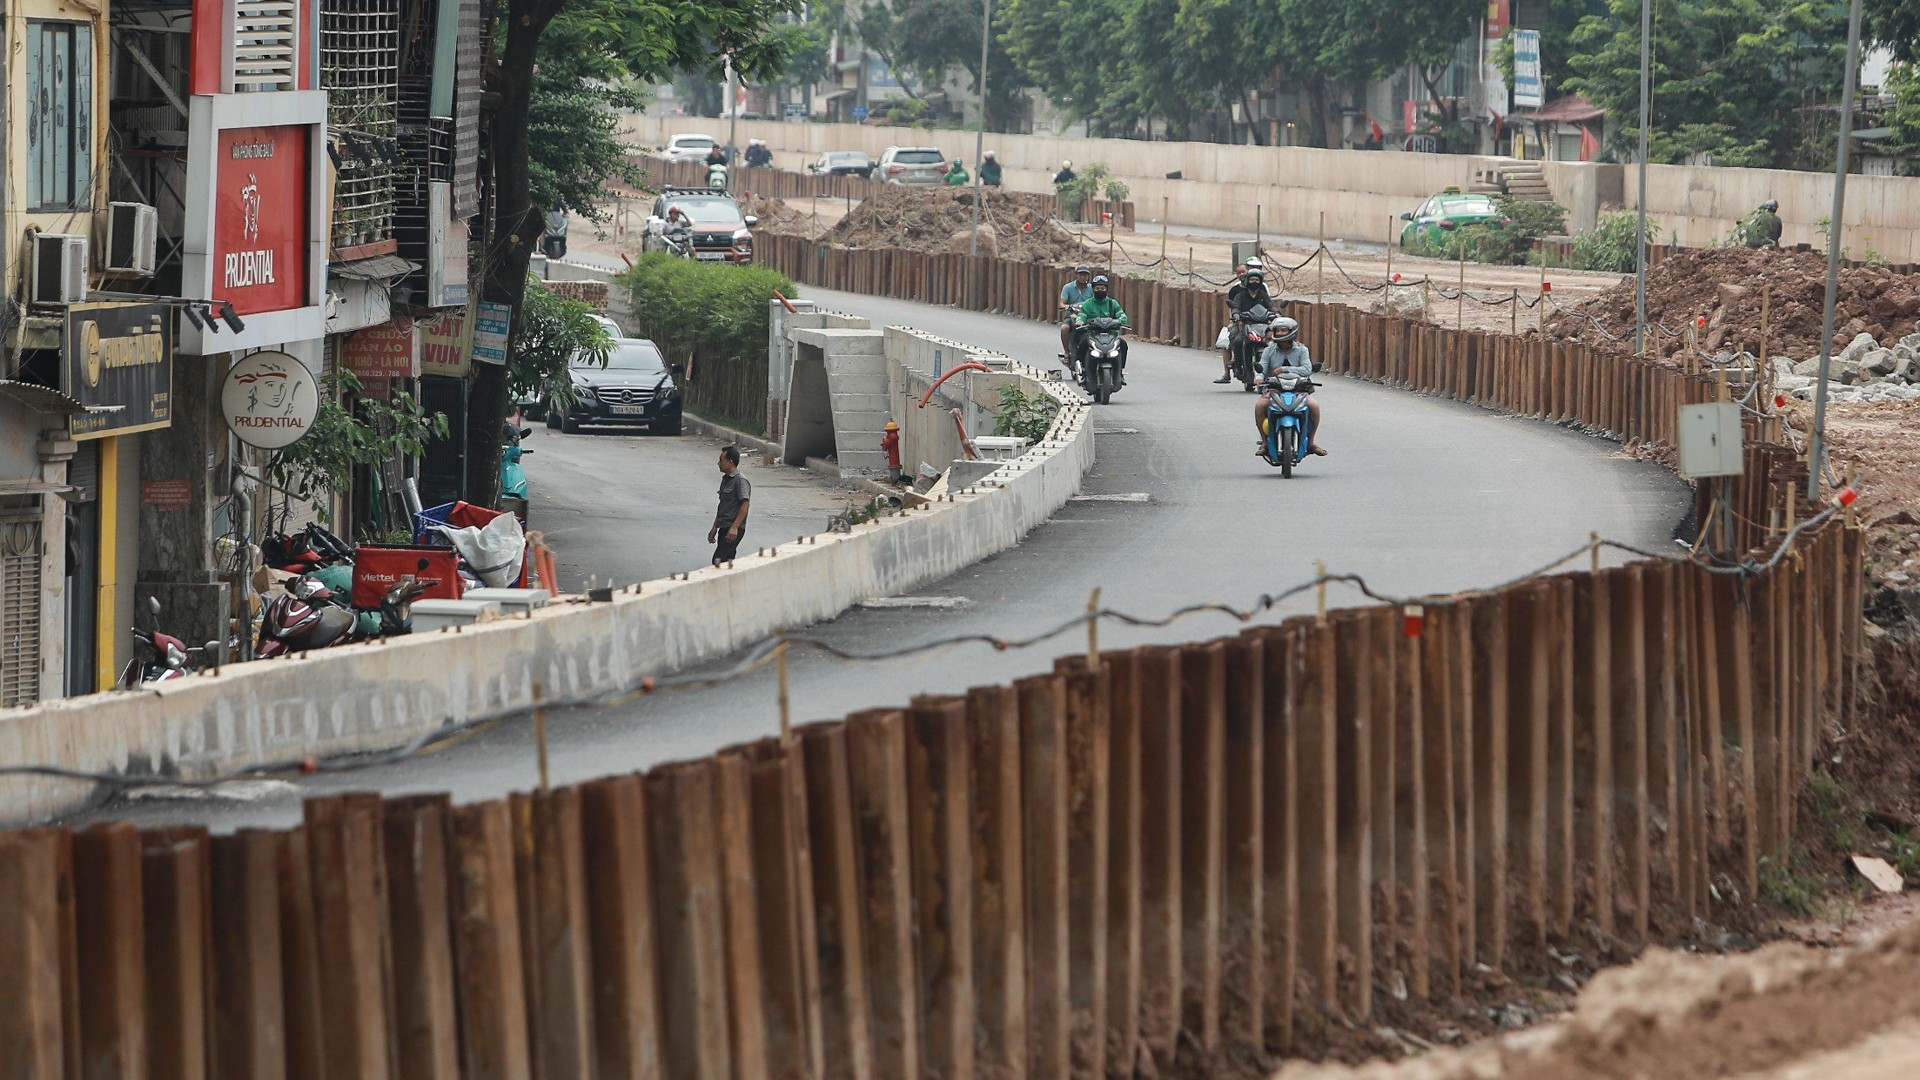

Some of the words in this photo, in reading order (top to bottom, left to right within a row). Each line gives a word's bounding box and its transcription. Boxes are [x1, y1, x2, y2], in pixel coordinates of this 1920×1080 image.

[225, 250, 275, 288] PRUDENTIAL
[384, 342, 403, 352] ÁO
[425, 342, 461, 367] VỤN
[234, 416, 305, 428] PRUDENTIAL
[361, 573, 395, 582] viettel
